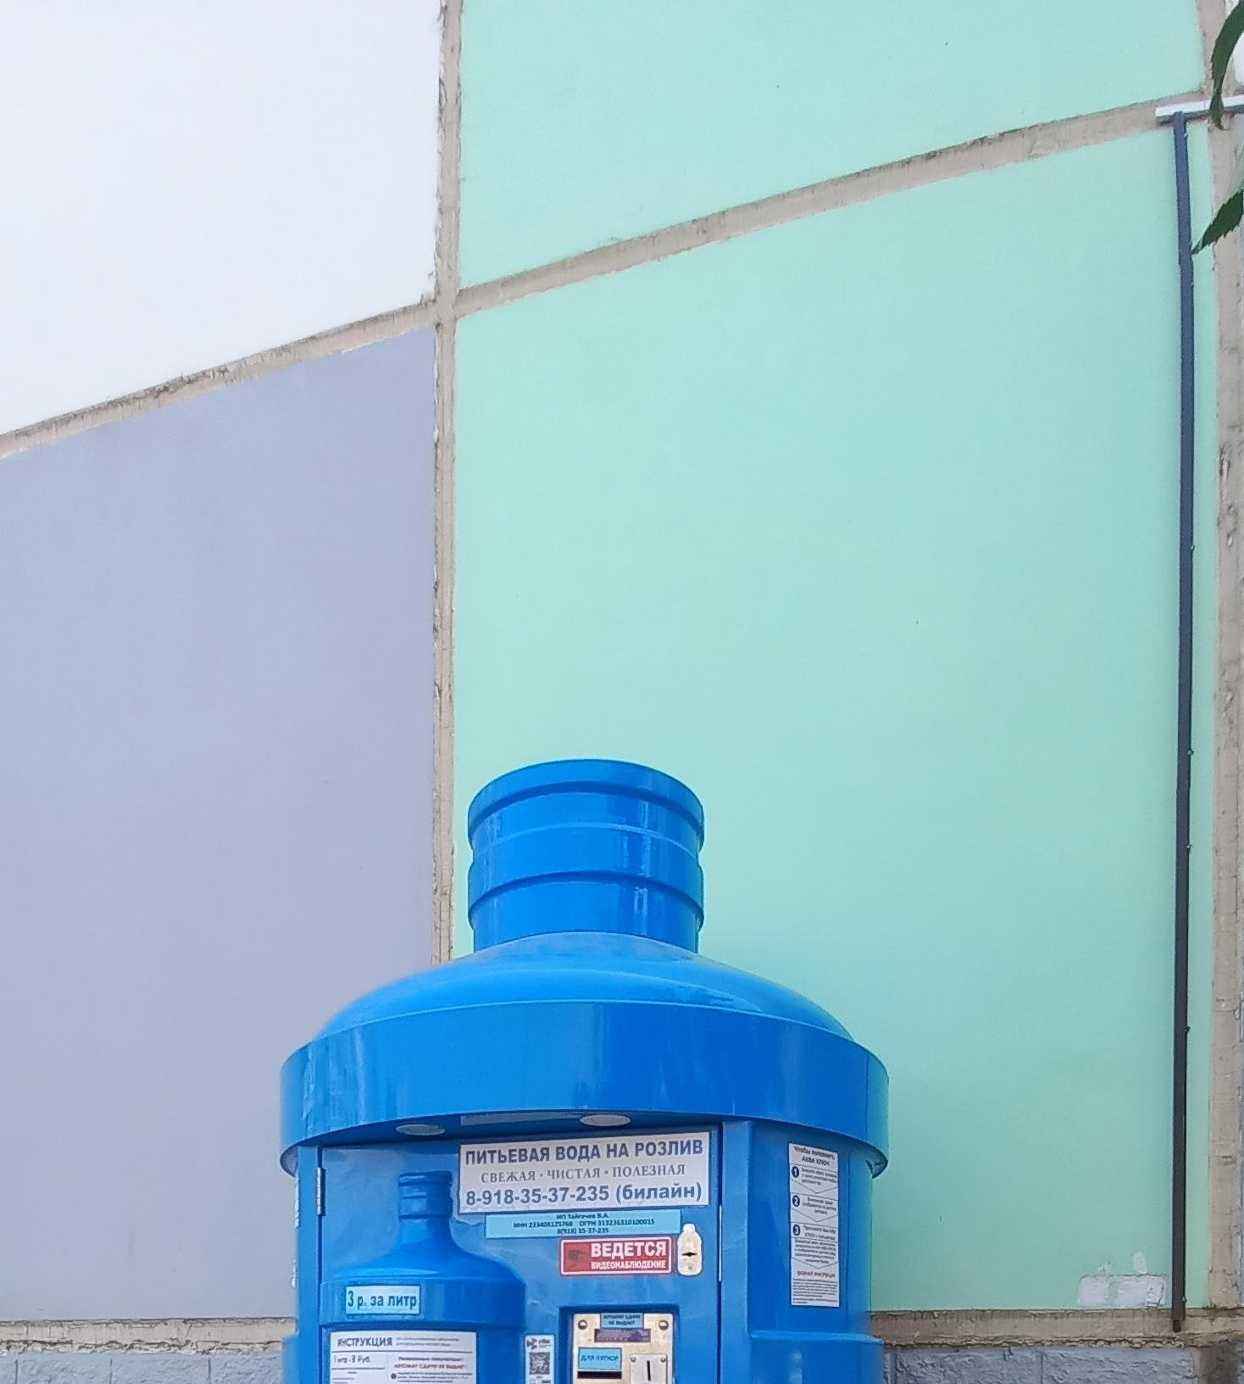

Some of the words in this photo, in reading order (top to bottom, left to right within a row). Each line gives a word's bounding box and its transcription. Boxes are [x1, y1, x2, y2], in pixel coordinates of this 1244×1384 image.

[465, 1147, 550, 1165] ПИТЬЕВАЯ
[556, 1144, 601, 1163] ВОДА
[606, 1143, 629, 1158] НА
[635, 1139, 704, 1157] РОЗЛИВ
[481, 1170, 536, 1184] СВЕЖАЯ
[546, 1168, 600, 1181] ЧИСТАЯ
[613, 1164, 685, 1178] ПОЛЕЗНАЯ
[466, 1184, 609, 1206] 8-918-35-37-235
[615, 1182, 702, 1203] (билайн)
[590, 1240, 667, 1259] ВЕДЕТСЯ
[590, 1259, 667, 1270] ВИДЕОНАБЛЮДЕНИЕ
[347, 1290, 354, 1307] 3
[371, 1296, 384, 1306] за
[388, 1294, 417, 1309] литр
[336, 1337, 393, 1348] ИНСТРУКЦИЯ
